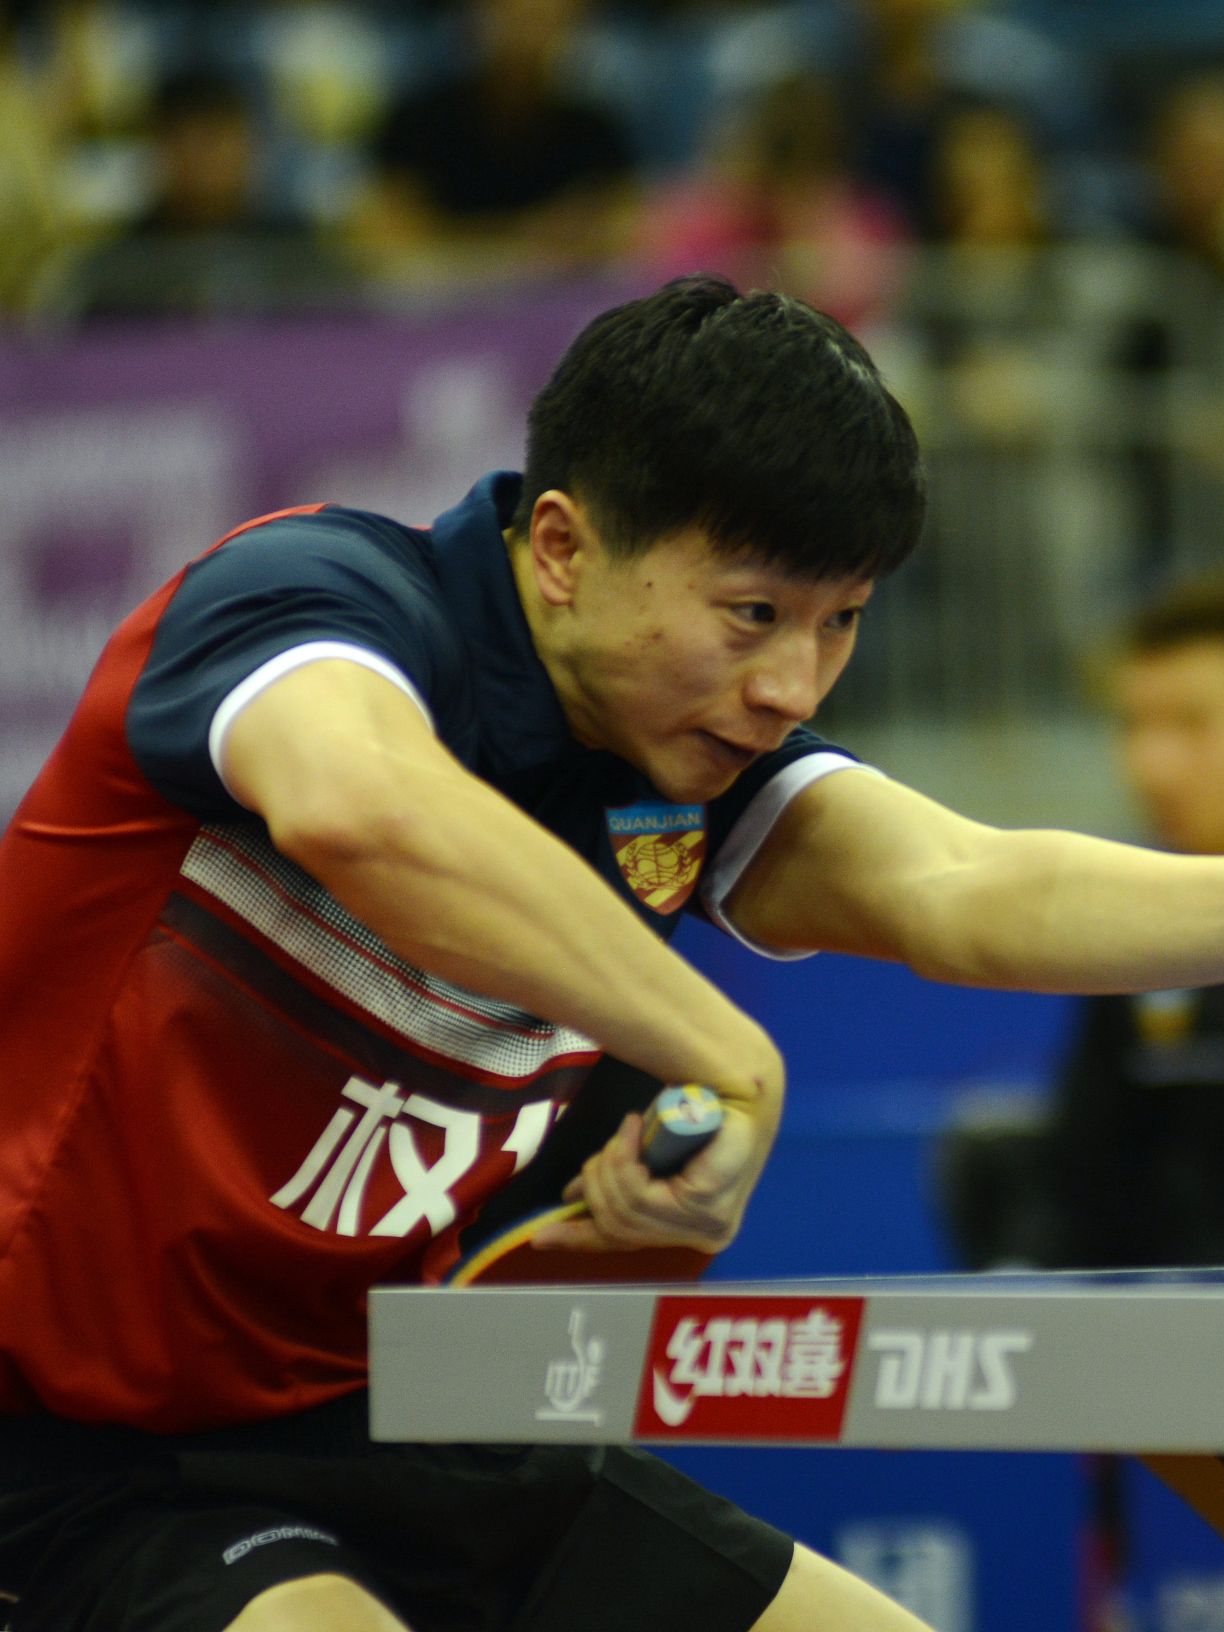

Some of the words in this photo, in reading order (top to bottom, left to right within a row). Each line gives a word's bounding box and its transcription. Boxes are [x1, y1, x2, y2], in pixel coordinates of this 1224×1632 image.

[608, 812, 701, 831] QUANJIAN
[268, 1074, 568, 1238] 权
[652, 1307, 847, 1427] 红双喜
[868, 1329, 1032, 1410] DHS
